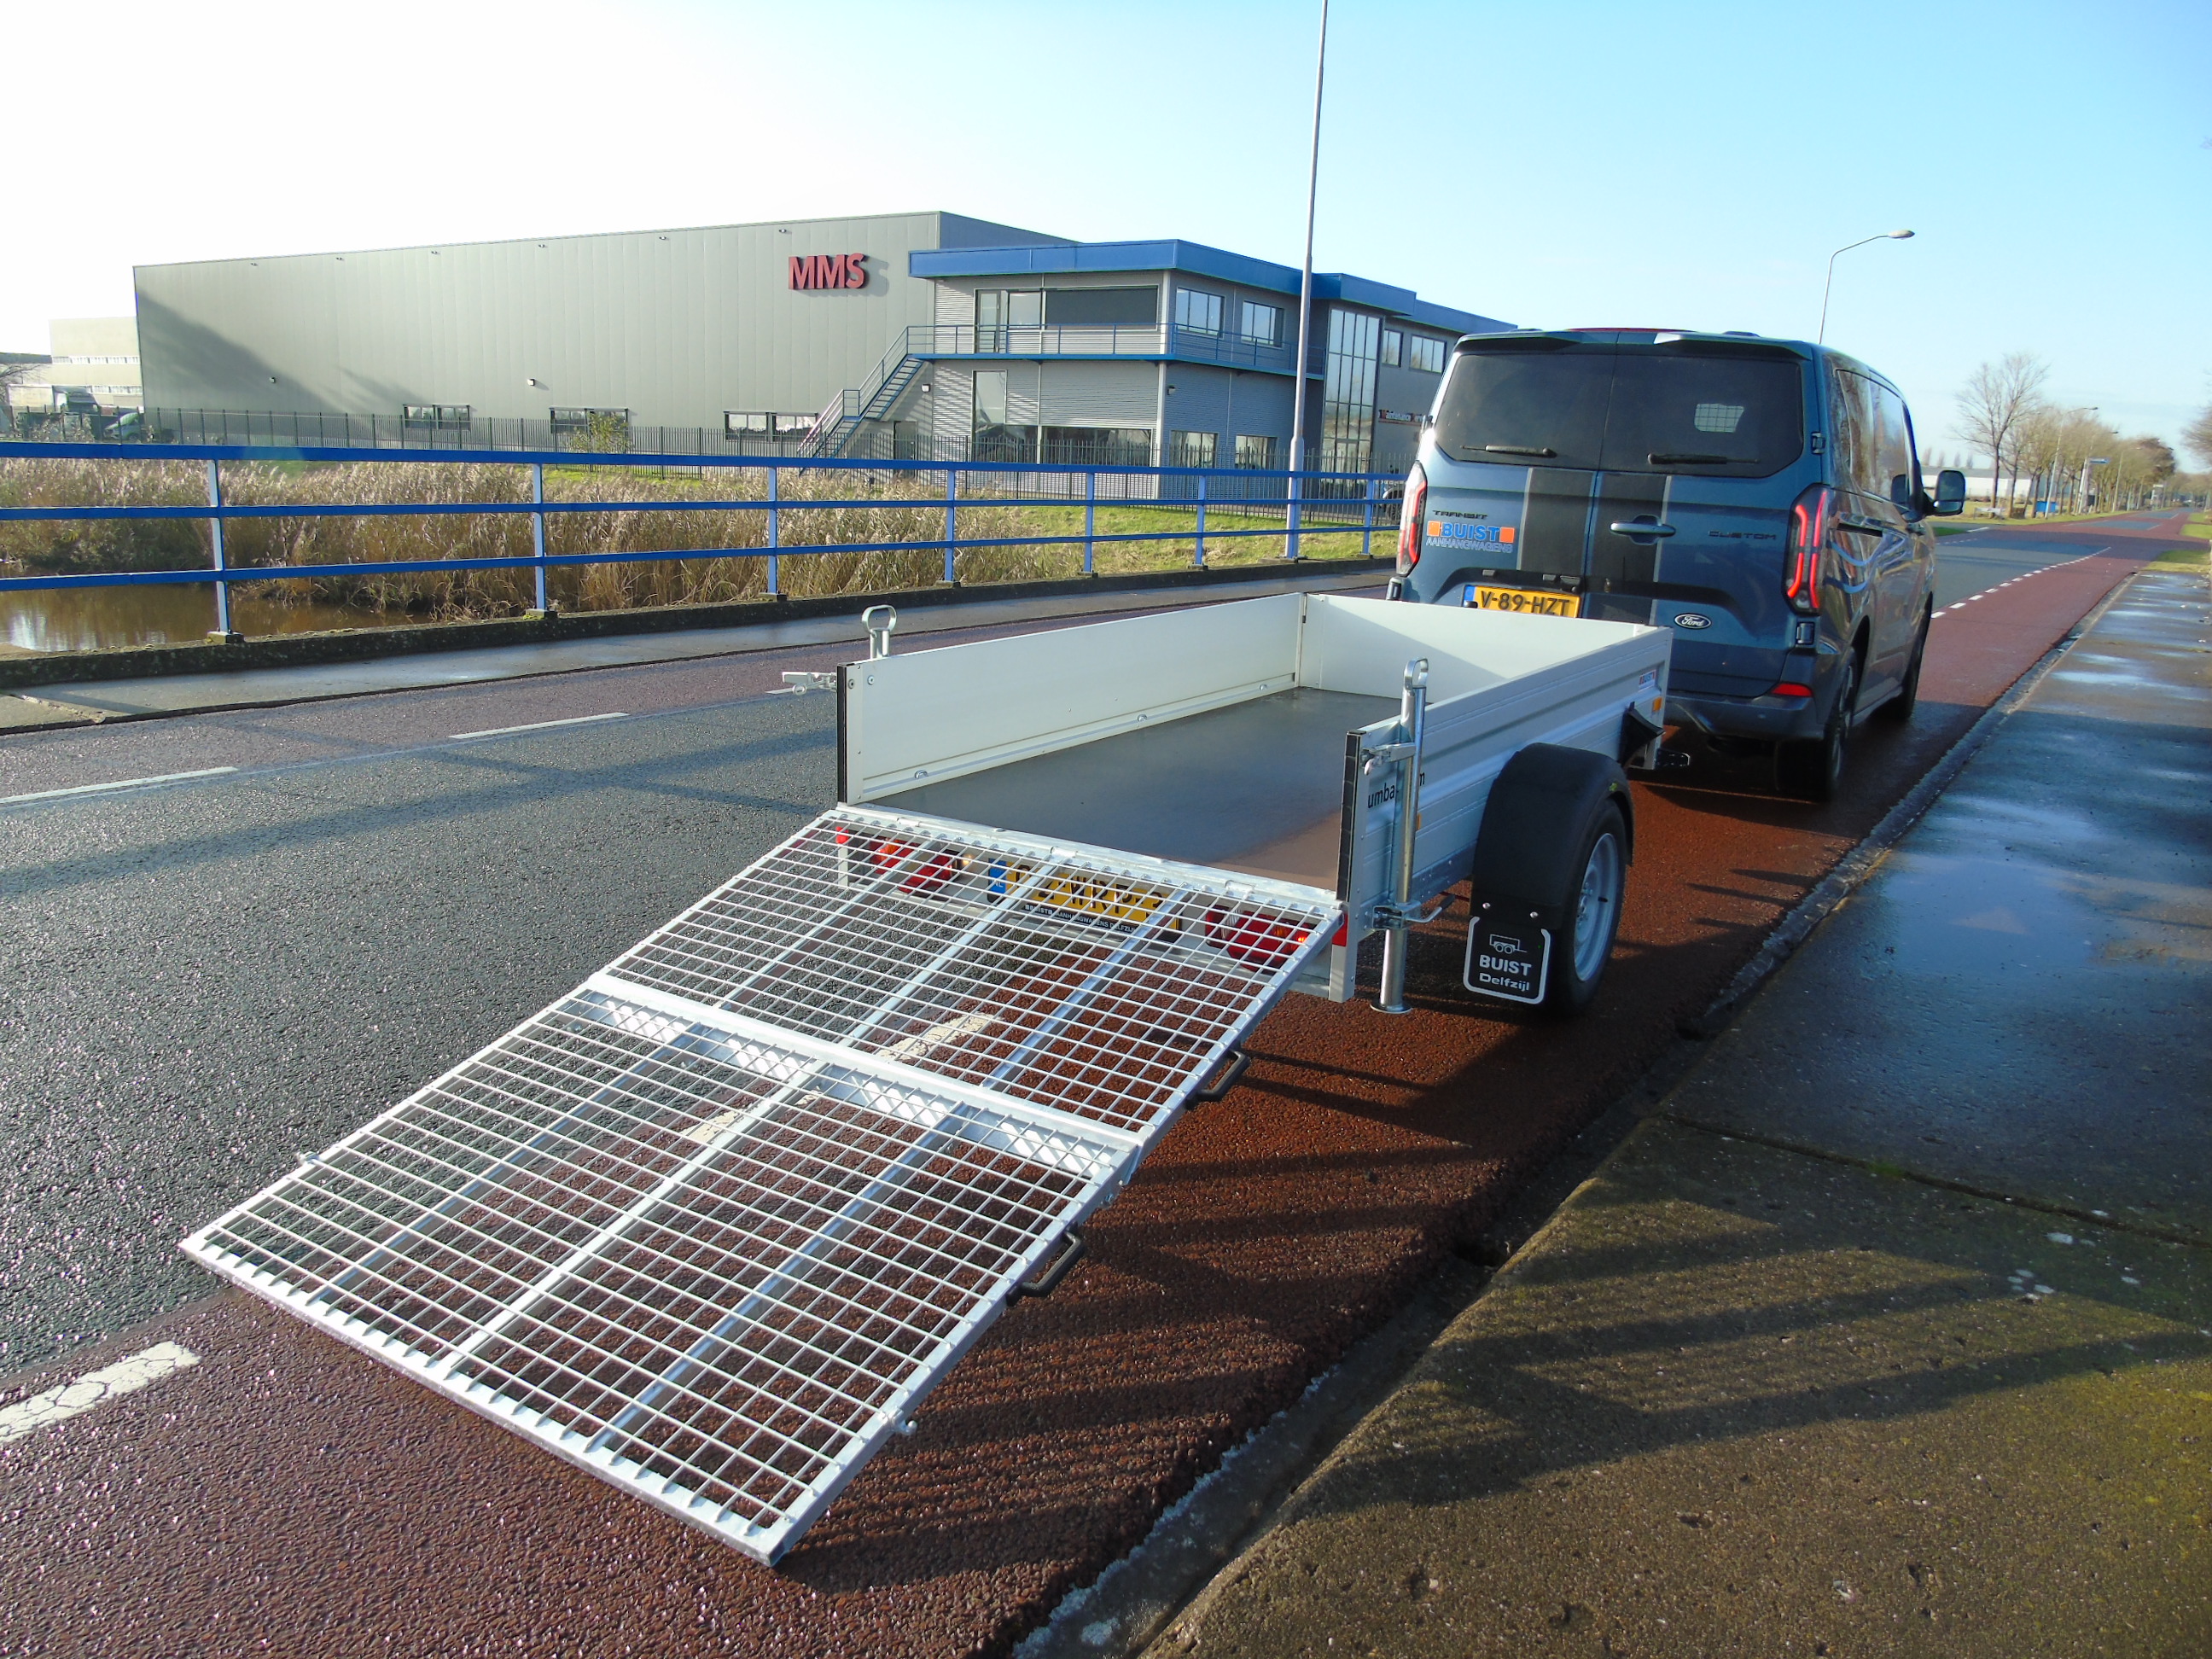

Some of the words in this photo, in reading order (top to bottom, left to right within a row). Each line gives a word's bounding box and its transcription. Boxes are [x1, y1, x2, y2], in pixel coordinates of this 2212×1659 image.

[789, 253, 868, 290] MMS
[1433, 509, 1487, 520] TRANSIT
[1440, 521, 1499, 542] BUIST
[1708, 530, 1776, 540] CUSTOM
[1425, 537, 1513, 555] AANHANGWAGENS
[1480, 590, 1570, 617] V-89-HZT
[1680, 614, 1706, 627] Ford
[1055, 911, 1109, 928] AANHNGWAENS
[1479, 954, 1532, 976] BUIST
[1479, 972, 1530, 992] Delfzijl
